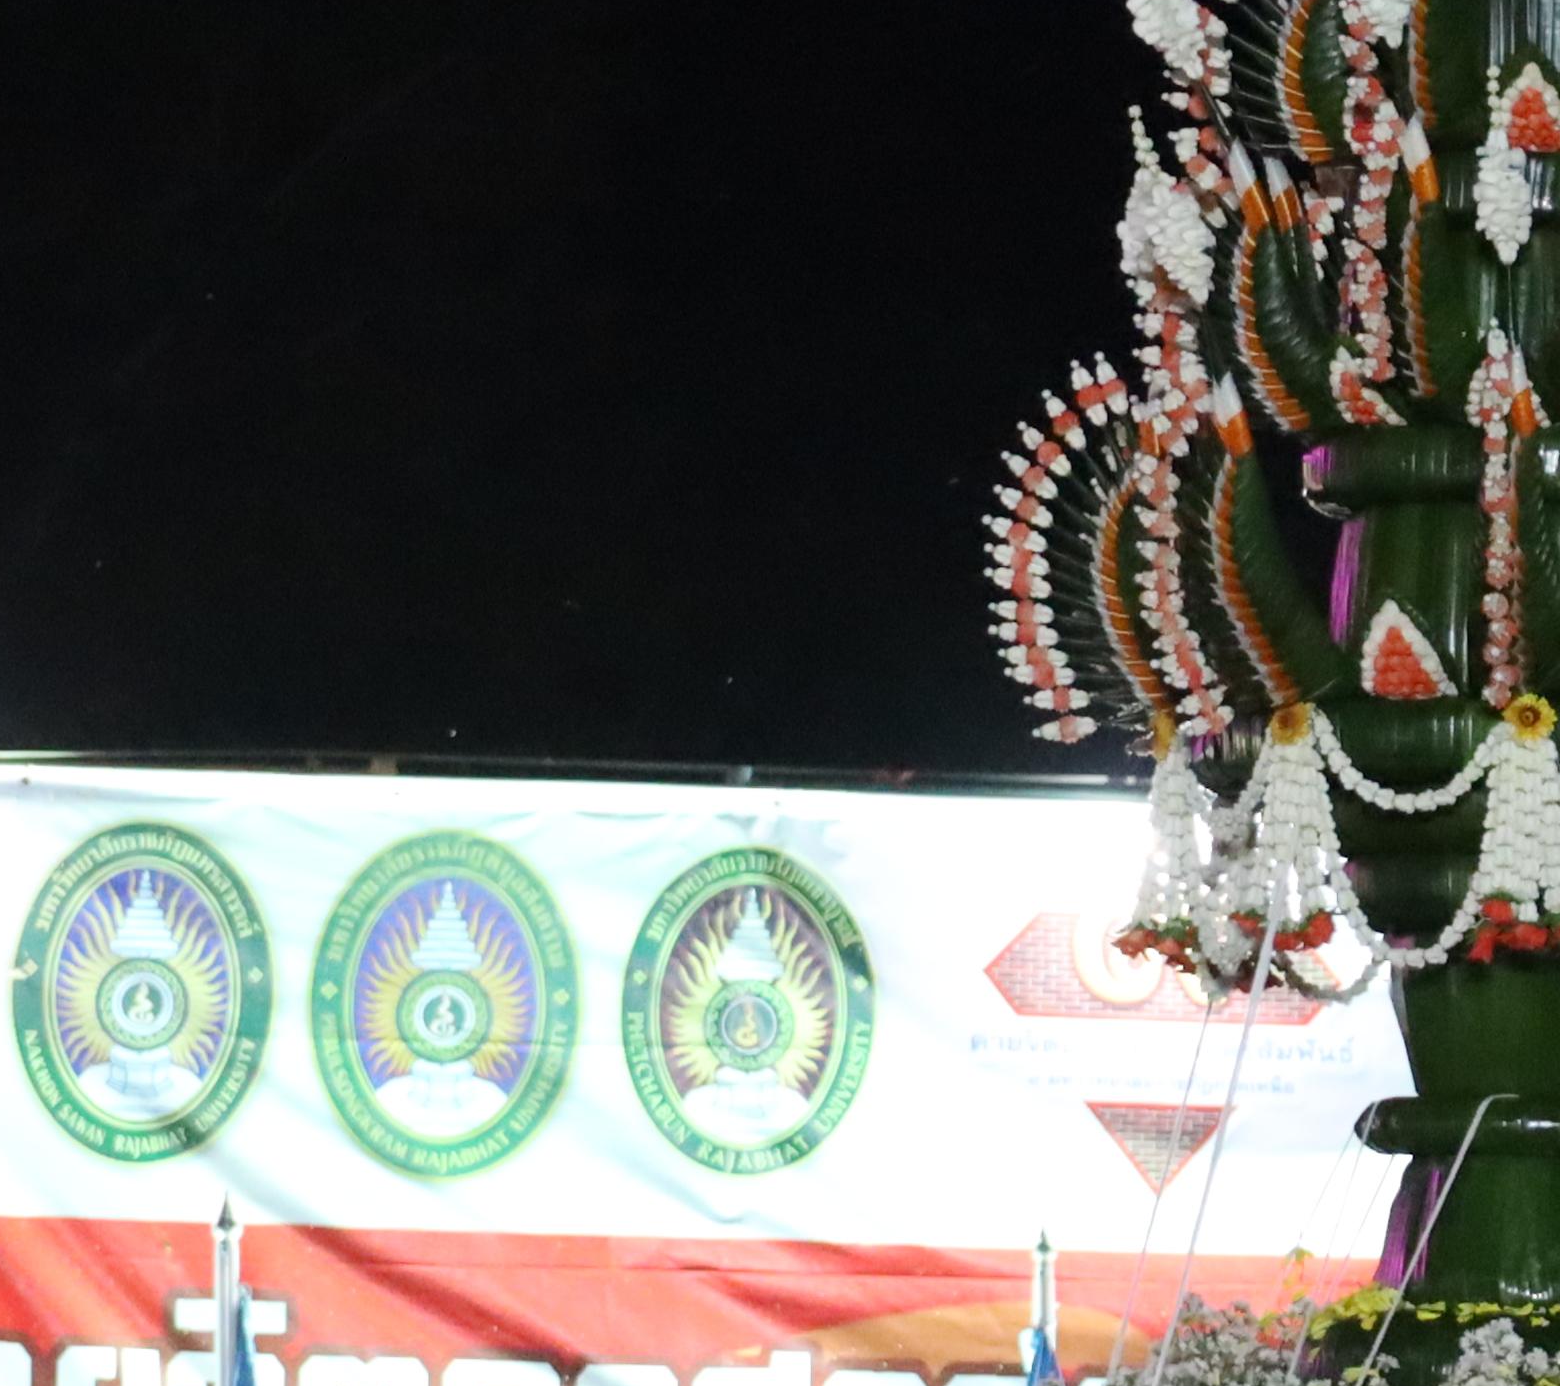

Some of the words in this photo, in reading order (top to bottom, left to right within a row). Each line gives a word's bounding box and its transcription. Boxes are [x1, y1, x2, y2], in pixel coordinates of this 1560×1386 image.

[111, 1122, 191, 1160] RAJABHAT
[190, 1035, 263, 1137] UNIVERSITY
[410, 1126, 514, 1176] RAJABHAT
[694, 1131, 810, 1175] RAJABHAT
[810, 1020, 872, 1140] UNIVERSITY
